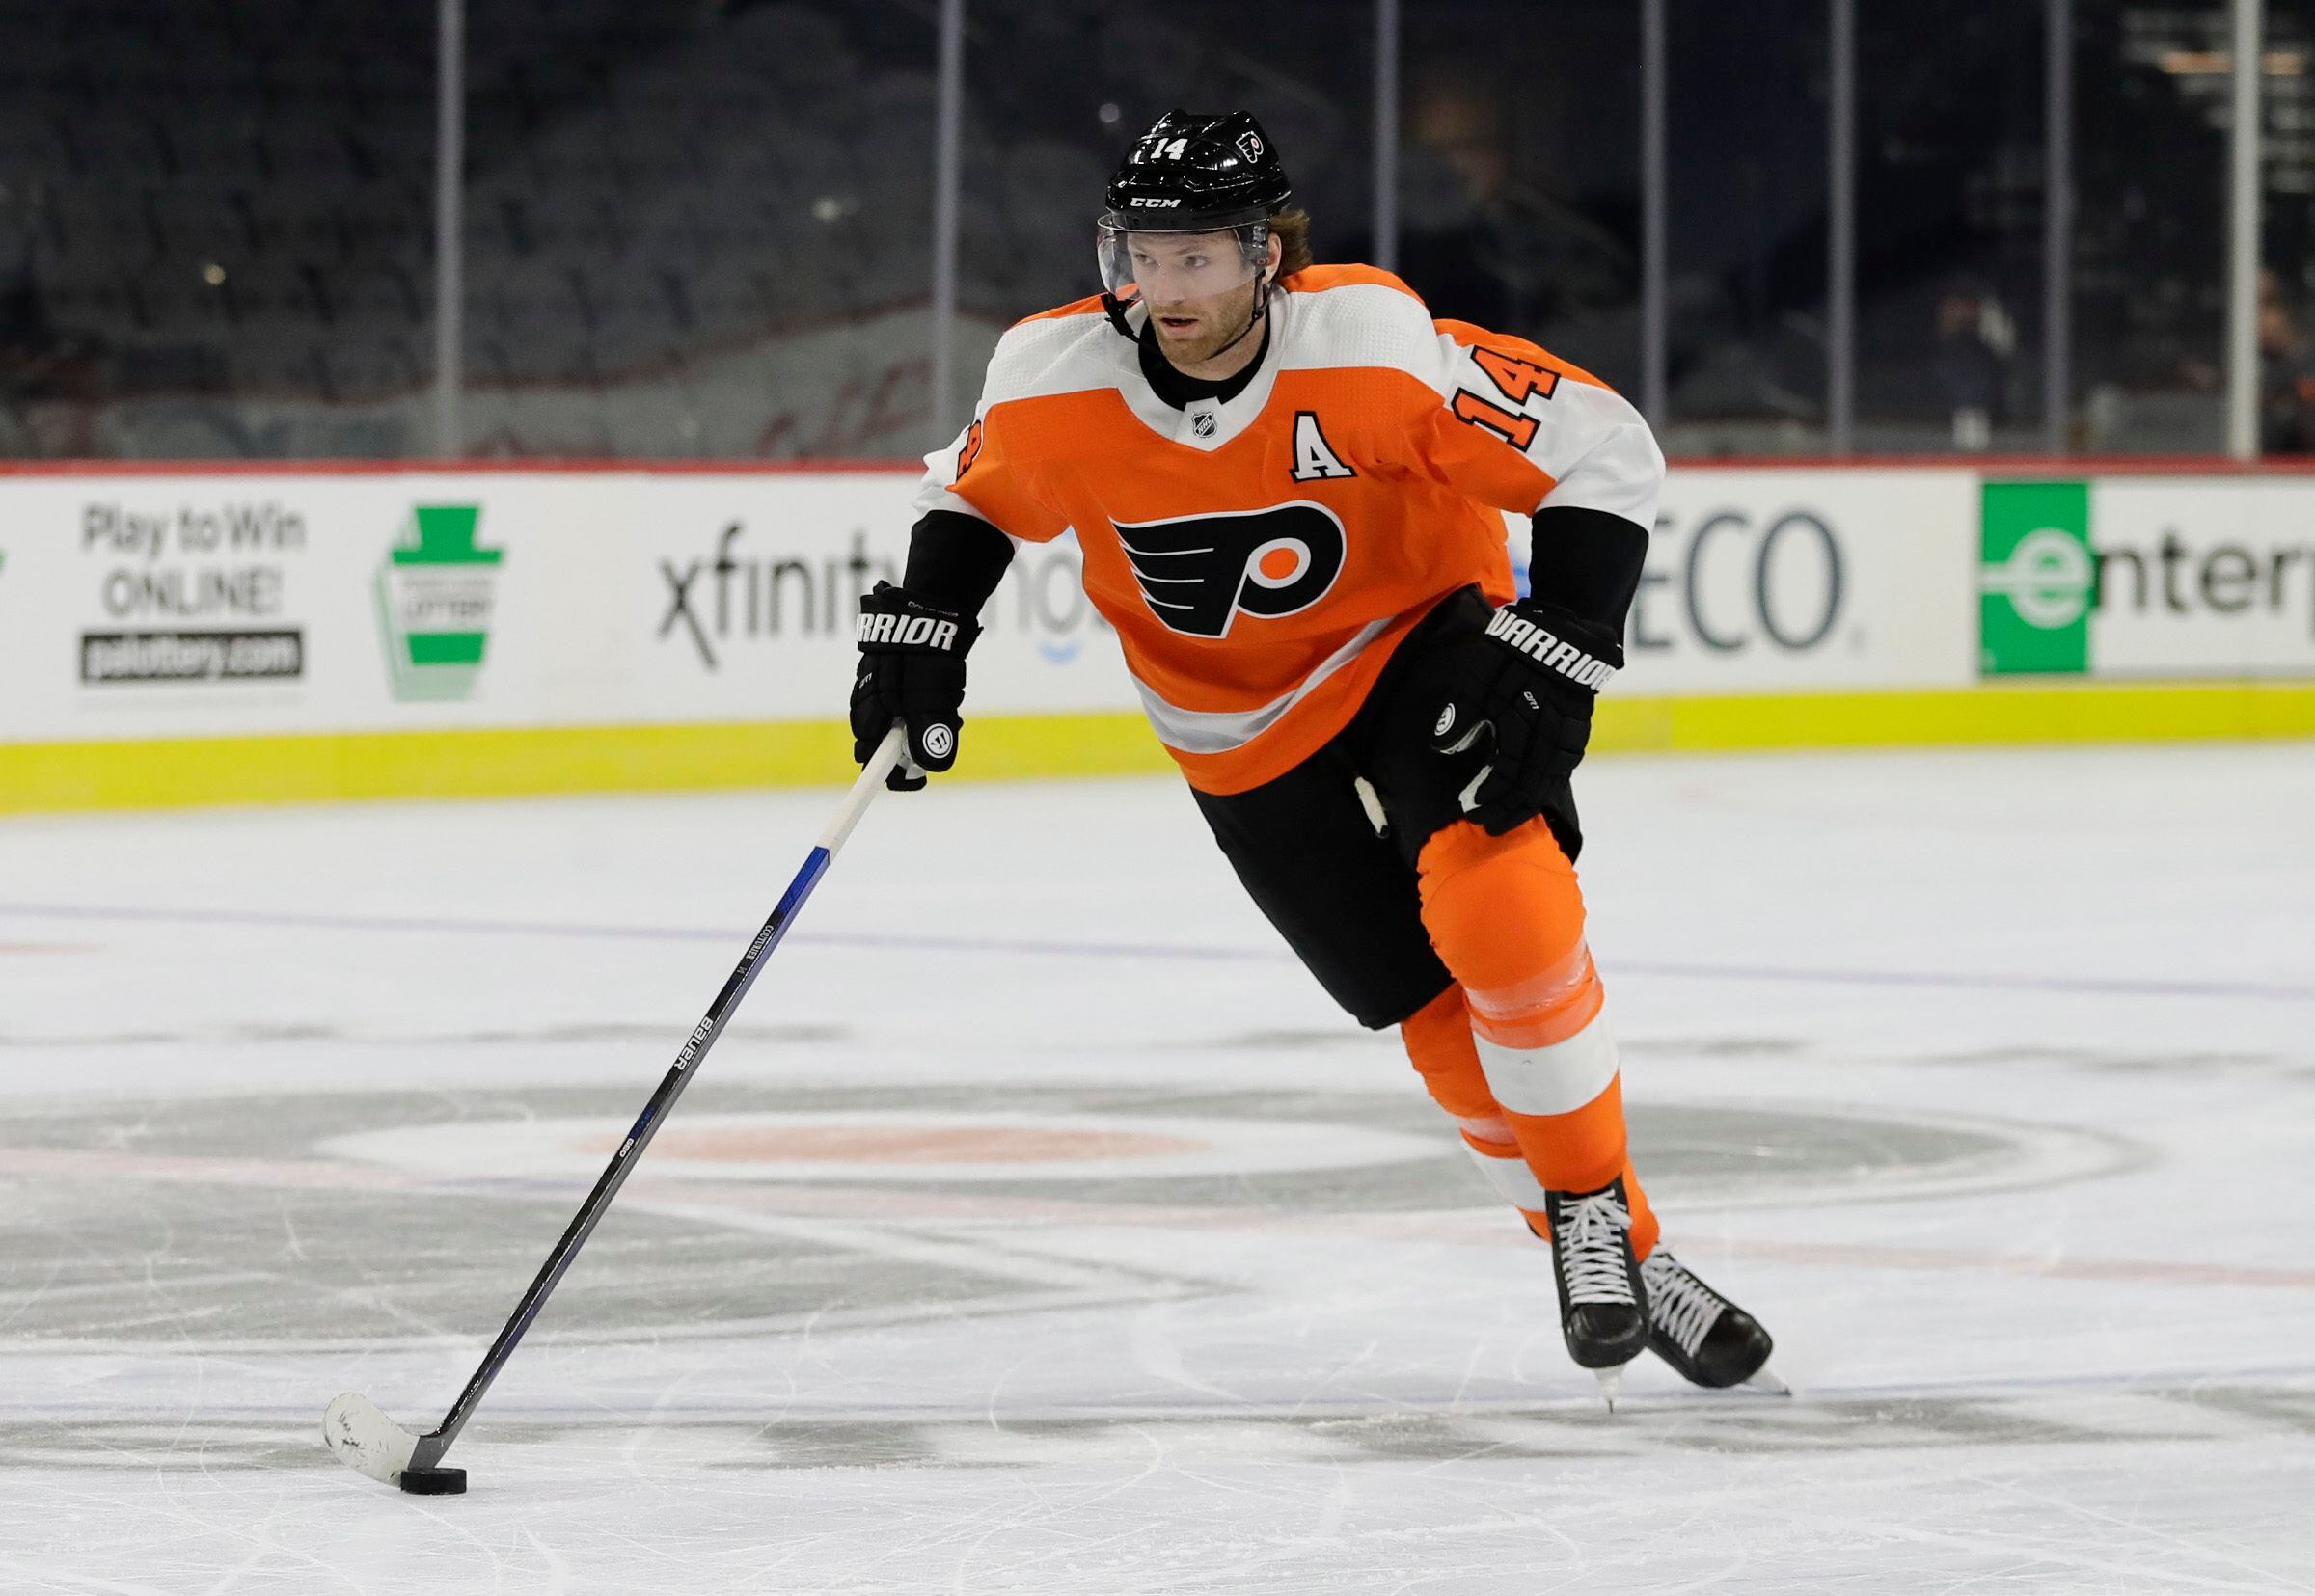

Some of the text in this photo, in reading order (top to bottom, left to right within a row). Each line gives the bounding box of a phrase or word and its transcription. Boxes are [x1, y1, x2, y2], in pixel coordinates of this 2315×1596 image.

[1150, 138, 1188, 160] 14
[1130, 197, 1181, 208] CCM
[1197, 417, 1212, 435] NHL
[1451, 345, 1561, 453] 14
[1289, 410, 1357, 483] A
[83, 501, 306, 561] Play to Win
[1633, 509, 1847, 651] ECO
[1983, 527, 2315, 633] enter
[857, 613, 958, 651] RRIOR
